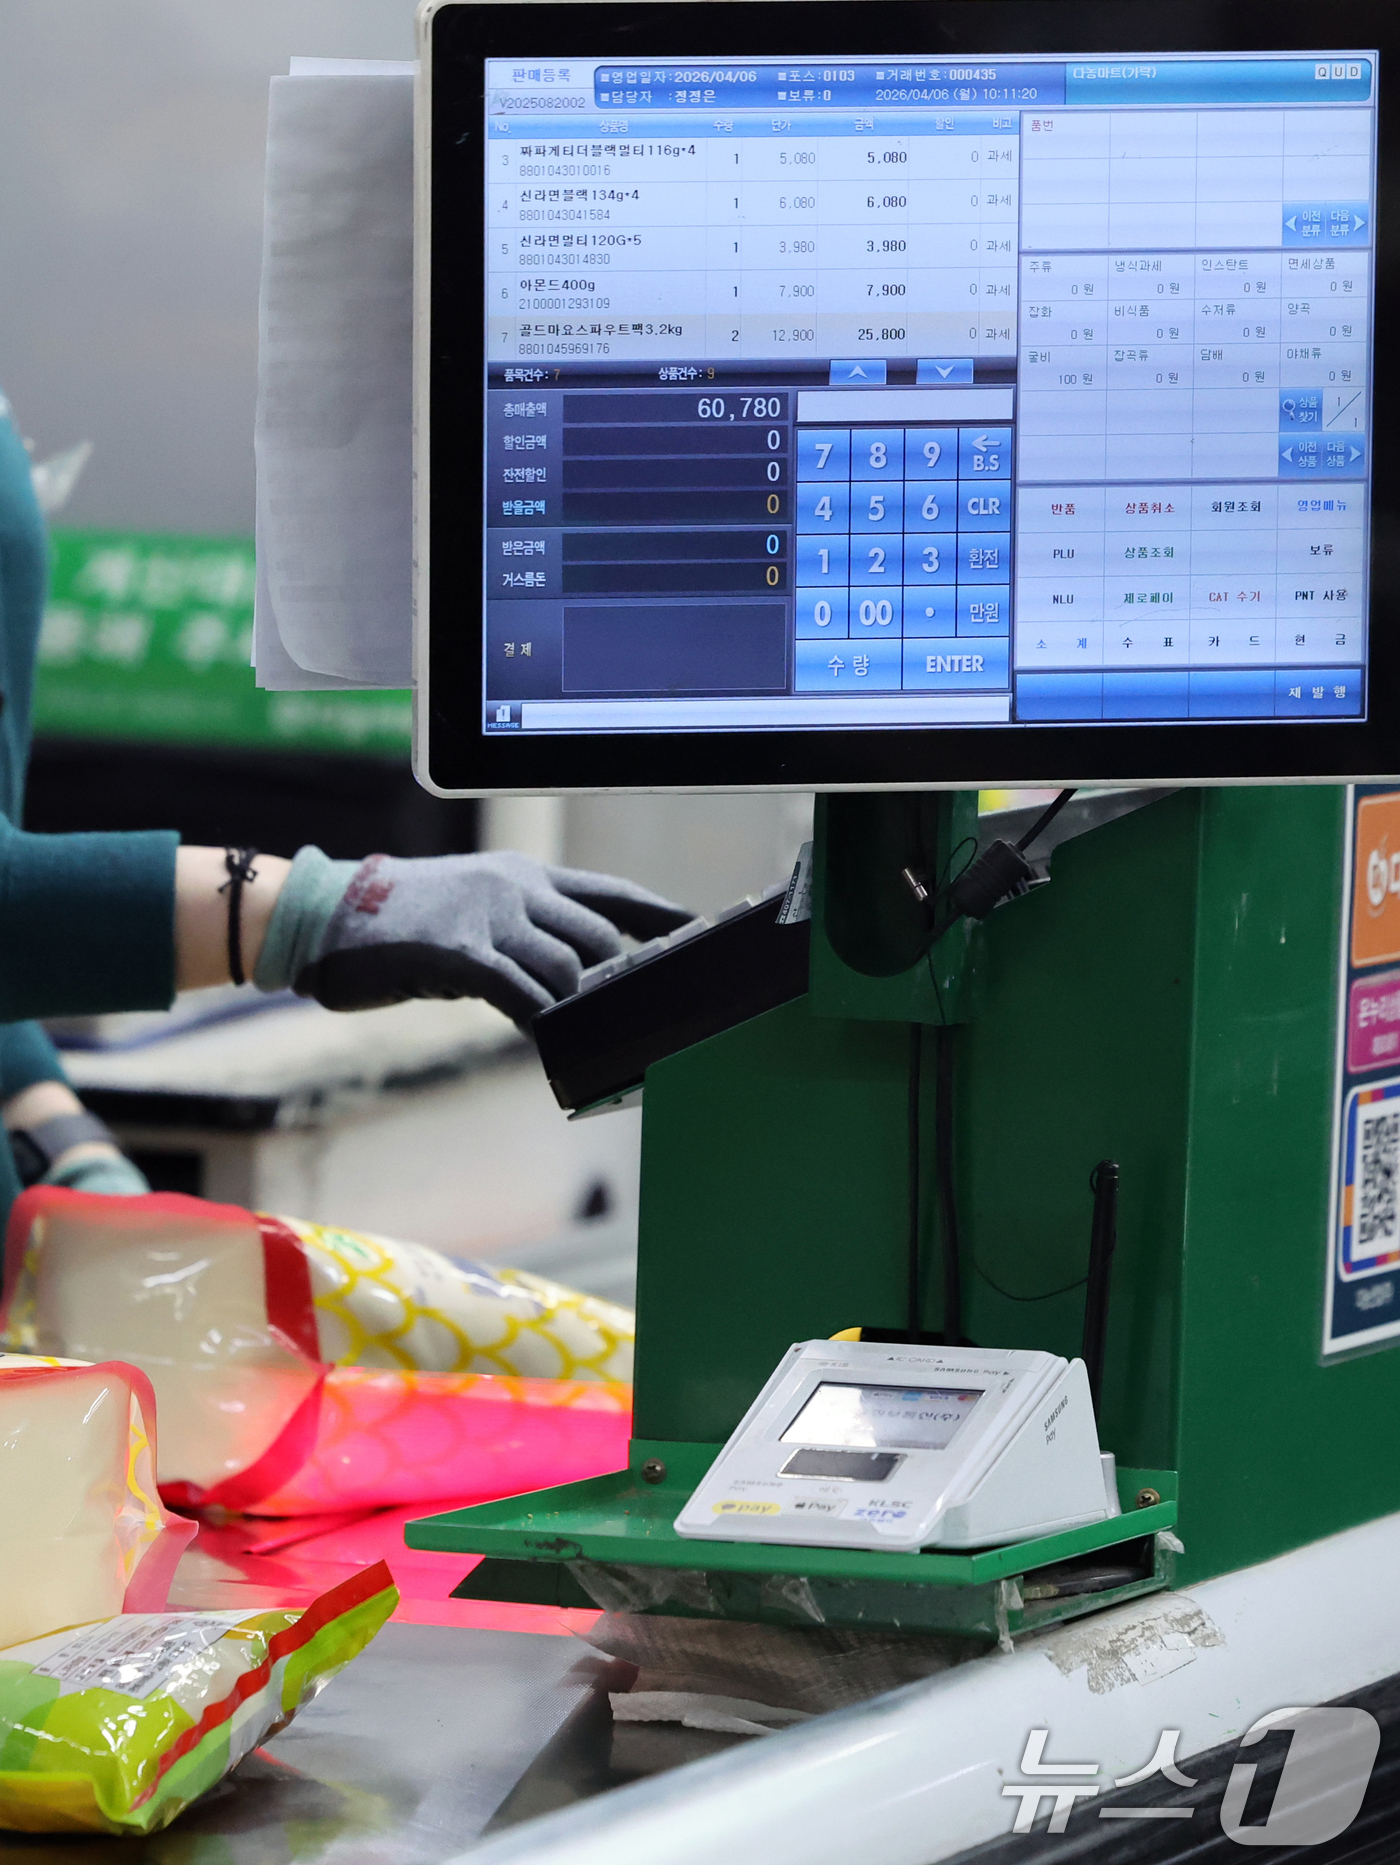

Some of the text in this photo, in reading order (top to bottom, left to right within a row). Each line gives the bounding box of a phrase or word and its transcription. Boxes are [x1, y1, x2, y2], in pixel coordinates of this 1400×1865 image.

[512, 68, 572, 83] 판매등록
[1073, 66, 1157, 79] 다농마트(가락)
[611, 90, 653, 104] 담당자
[875, 87, 1038, 102] 2026/04/06 (월) 10:11:20
[499, 97, 586, 109] V2025082002
[494, 121, 512, 133] No.
[599, 119, 629, 133] 상품명
[712, 119, 734, 132] 수량
[771, 119, 792, 133] 단가
[854, 117, 875, 131] 금액
[934, 117, 955, 131] 할인
[992, 117, 1013, 130] 비고
[1031, 119, 1054, 132] 품번
[502, 155, 510, 166] 3
[733, 153, 739, 165] 1
[779, 152, 816, 165] 5,080
[867, 152, 907, 165] 5,080
[987, 150, 1013, 162] 과세
[519, 165, 611, 177] 8801043010016
[501, 199, 509, 210] 4
[733, 197, 739, 209] 1
[779, 196, 816, 210] 6,080
[867, 195, 907, 209] 6,080
[986, 194, 1012, 207] 과세
[519, 209, 611, 221] 8801043041584
[1302, 209, 1350, 222] 이전 다음
[1302, 224, 1350, 237] 분류 분류
[501, 244, 509, 255] 5
[733, 242, 739, 253] 1
[779, 240, 815, 254] 3,980
[866, 239, 907, 253] 3,980
[986, 239, 1011, 252] 과세
[518, 254, 611, 266] 8801043014830
[1115, 260, 1162, 273] 냉식과세
[1201, 259, 1249, 272] 인스탄트
[1288, 258, 1336, 271] 면세상품
[1029, 261, 1052, 274] 주류
[501, 279, 1011, 299] 6 아몬드400g 1 7,900 7,900 과세
[1071, 283, 1094, 296] 0 원
[1157, 282, 1180, 295] 0 원
[1243, 281, 1267, 294] 0 원
[1330, 280, 1353, 293] 0 원
[518, 298, 611, 310] 2100001293109
[1114, 304, 1150, 317] 비식품
[1201, 303, 1236, 316] 수저류
[1287, 302, 1311, 315] 양곡
[1028, 306, 1052, 319] 잡화
[502, 332, 508, 343] 7
[731, 330, 740, 342] 2
[772, 329, 815, 343] 12,900
[858, 328, 906, 342] 25,800
[985, 328, 1010, 340] 과세
[518, 343, 610, 355] 8801045969176
[1114, 349, 1150, 362] 잡곡류
[1200, 348, 1224, 361] 담배
[1286, 347, 1322, 360] 야채류
[1028, 350, 1051, 363] 굴비
[553, 368, 561, 380] 7
[707, 367, 715, 380] 9
[1058, 373, 1094, 385] 100 원
[1299, 396, 1318, 408] 상품
[503, 397, 781, 421] 총매출액 60,780
[1298, 410, 1318, 423] 찾기
[503, 429, 780, 450] 할인금액 0
[1298, 440, 1346, 453] 이전 다음
[814, 441, 1000, 471] 7 8 9 B.S
[1298, 455, 1345, 468] 상품 상품
[767, 461, 780, 482] 0
[502, 493, 780, 516] 받을금액 0
[814, 494, 1000, 521] 4 5 6 CLR
[1051, 503, 1076, 516] 반품
[1125, 502, 1176, 515] 상품취소
[1211, 500, 1262, 513] 회원조회
[1297, 499, 1348, 512] 영업메뉴
[502, 534, 780, 556] 받은금액 0
[1310, 544, 1334, 556] 보류
[1053, 548, 1075, 560] PLU
[1124, 546, 1175, 559] 상품조회
[817, 546, 999, 574] 1 2 3 환전
[502, 565, 780, 588] 거스름돈 0
[1052, 594, 1074, 605] NLU
[1123, 591, 1174, 604] 제로페이
[1209, 590, 1261, 603] CAT 수기
[1295, 589, 1348, 602] PNT 사용
[814, 599, 1000, 627] 0 00 만원
[926, 654, 984, 674] ENTER
[1043, 1395, 1069, 1432] SAMSUNG
